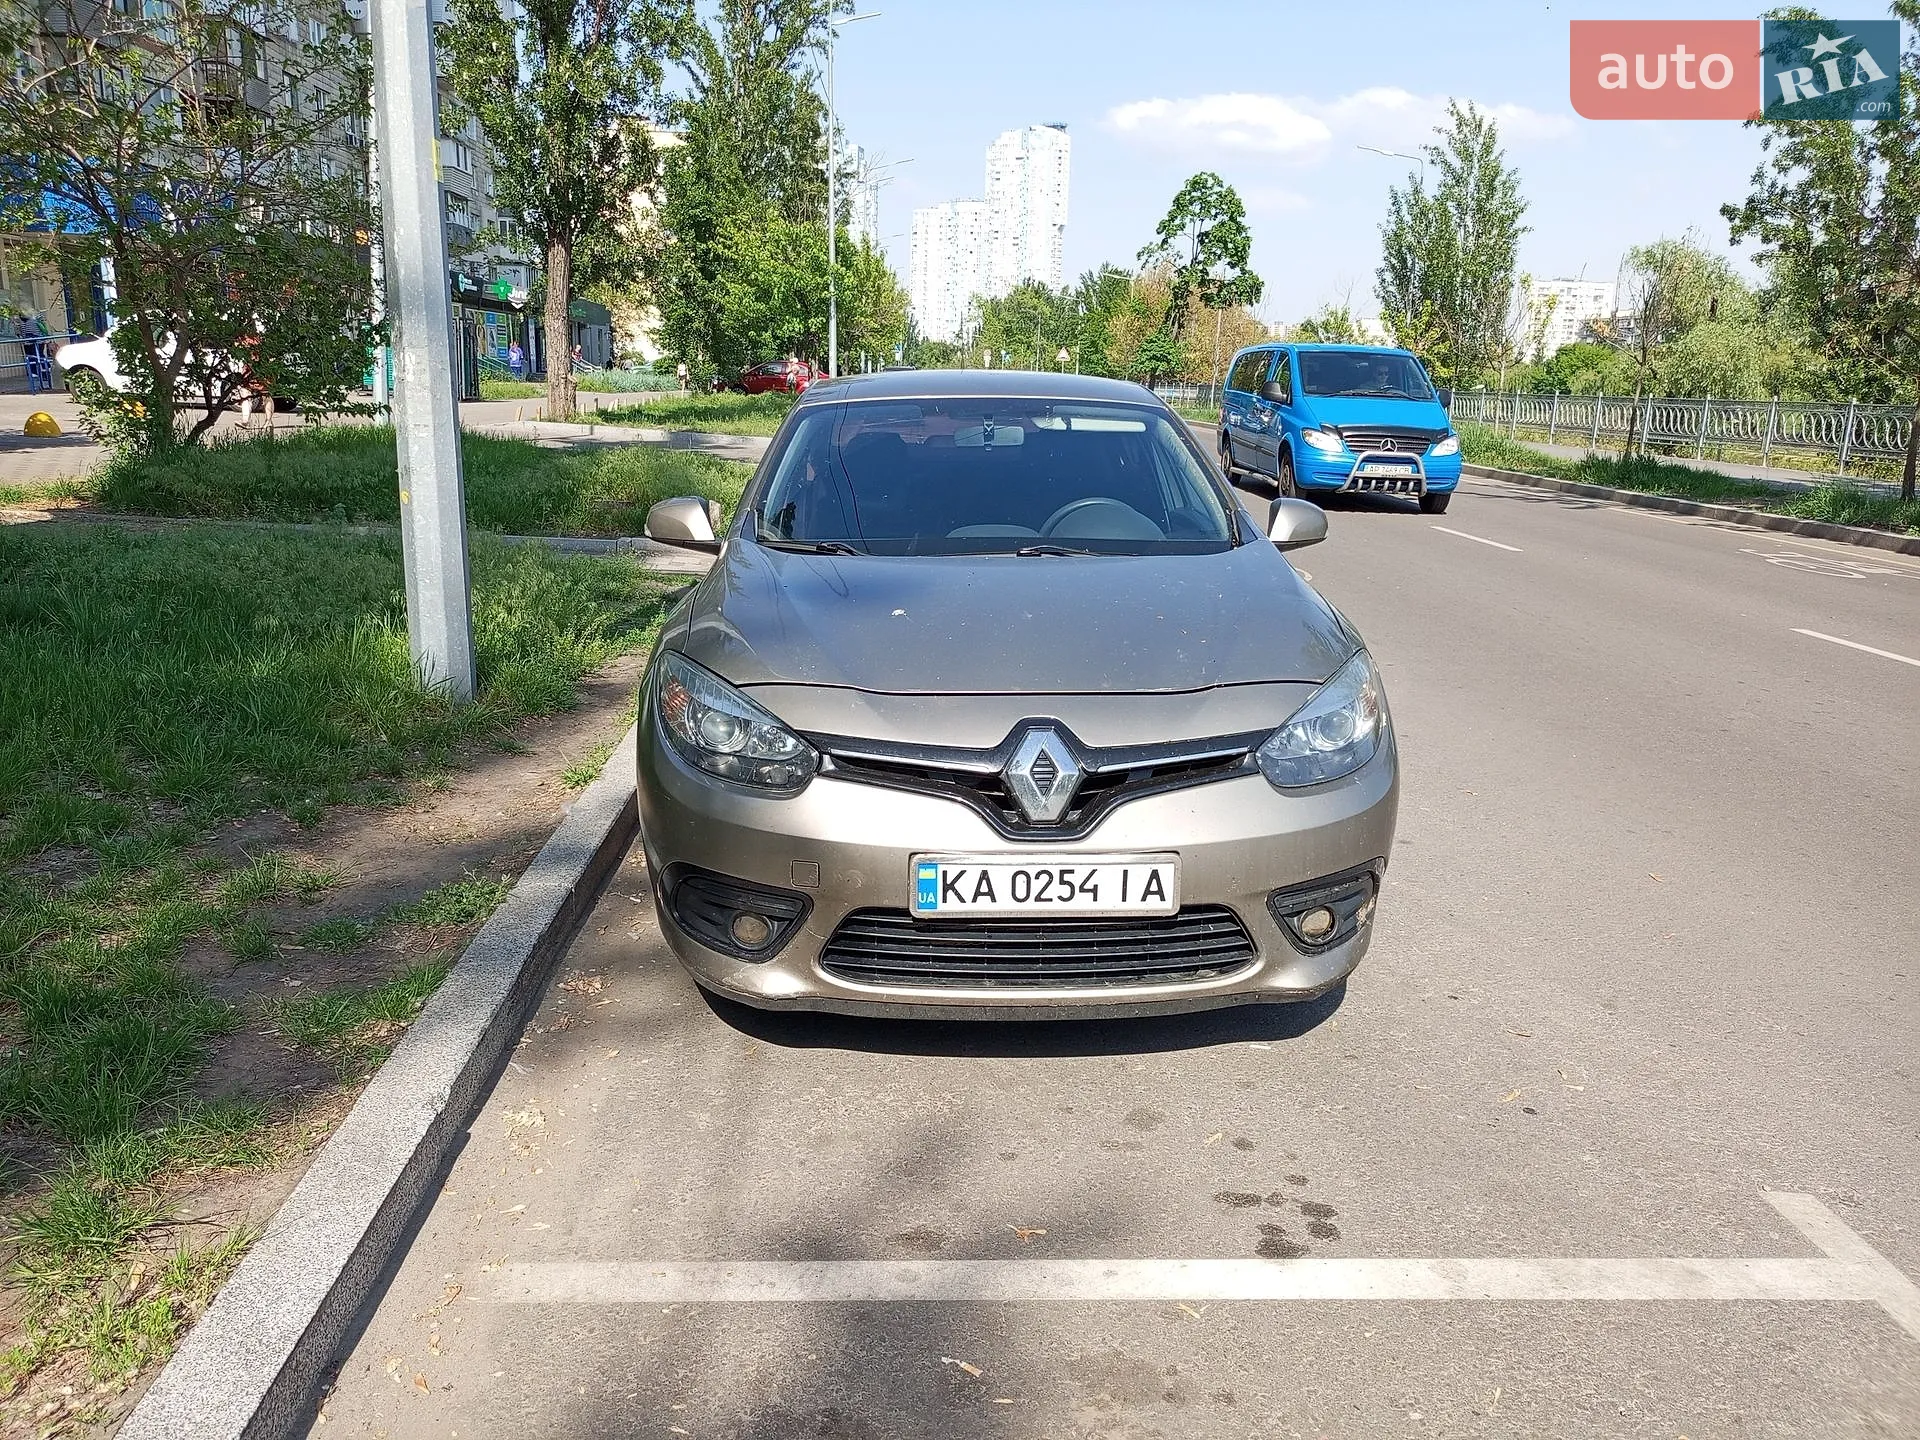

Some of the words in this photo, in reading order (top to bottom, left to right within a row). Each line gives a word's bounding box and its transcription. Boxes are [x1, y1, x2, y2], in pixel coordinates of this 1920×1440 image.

[918, 891, 936, 904] UA
[942, 869, 997, 904] KA
[1011, 869, 1099, 903] 0254
[1121, 869, 1166, 902] IA
